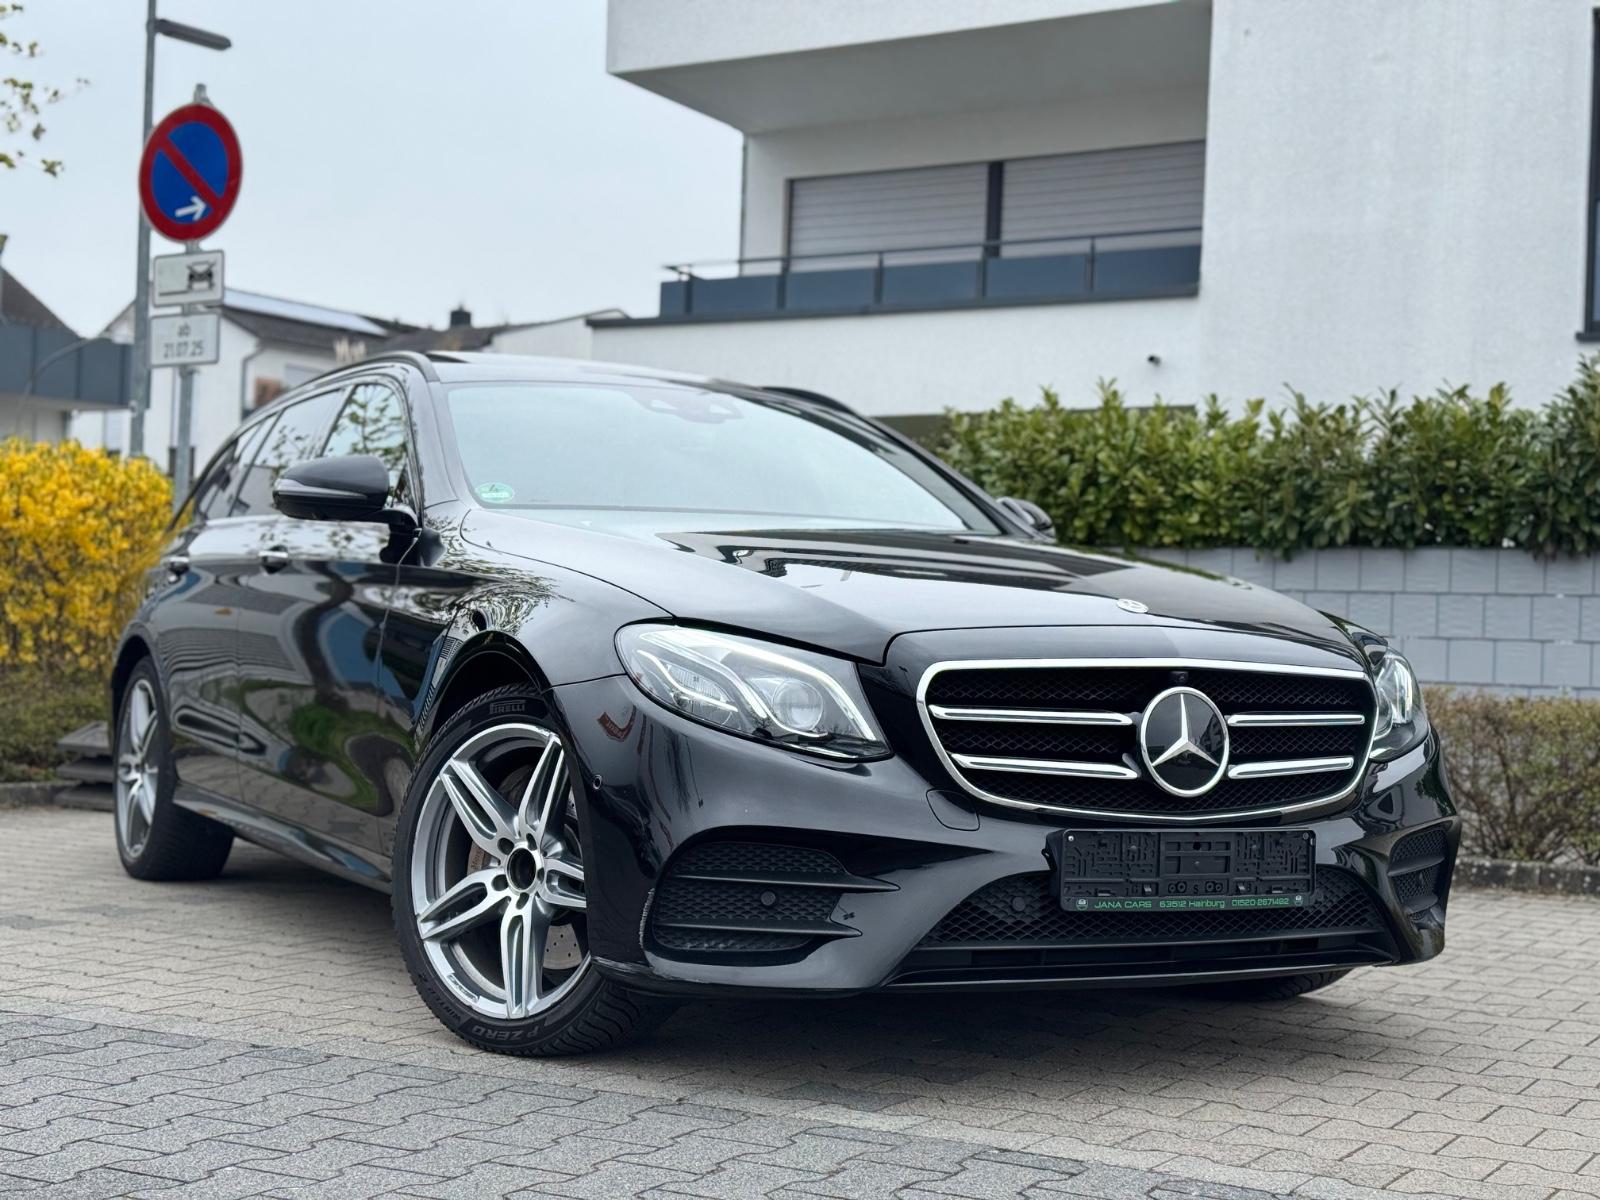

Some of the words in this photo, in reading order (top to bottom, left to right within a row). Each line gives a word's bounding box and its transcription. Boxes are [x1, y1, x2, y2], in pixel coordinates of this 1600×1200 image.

[490, 700, 526, 714] PIRELLI
[1094, 901, 1122, 909] JANA
[1124, 900, 1152, 909] CARS
[1159, 900, 1187, 908] 63512
[471, 1025, 525, 1041] ZERO
[526, 1025, 540, 1038] P
